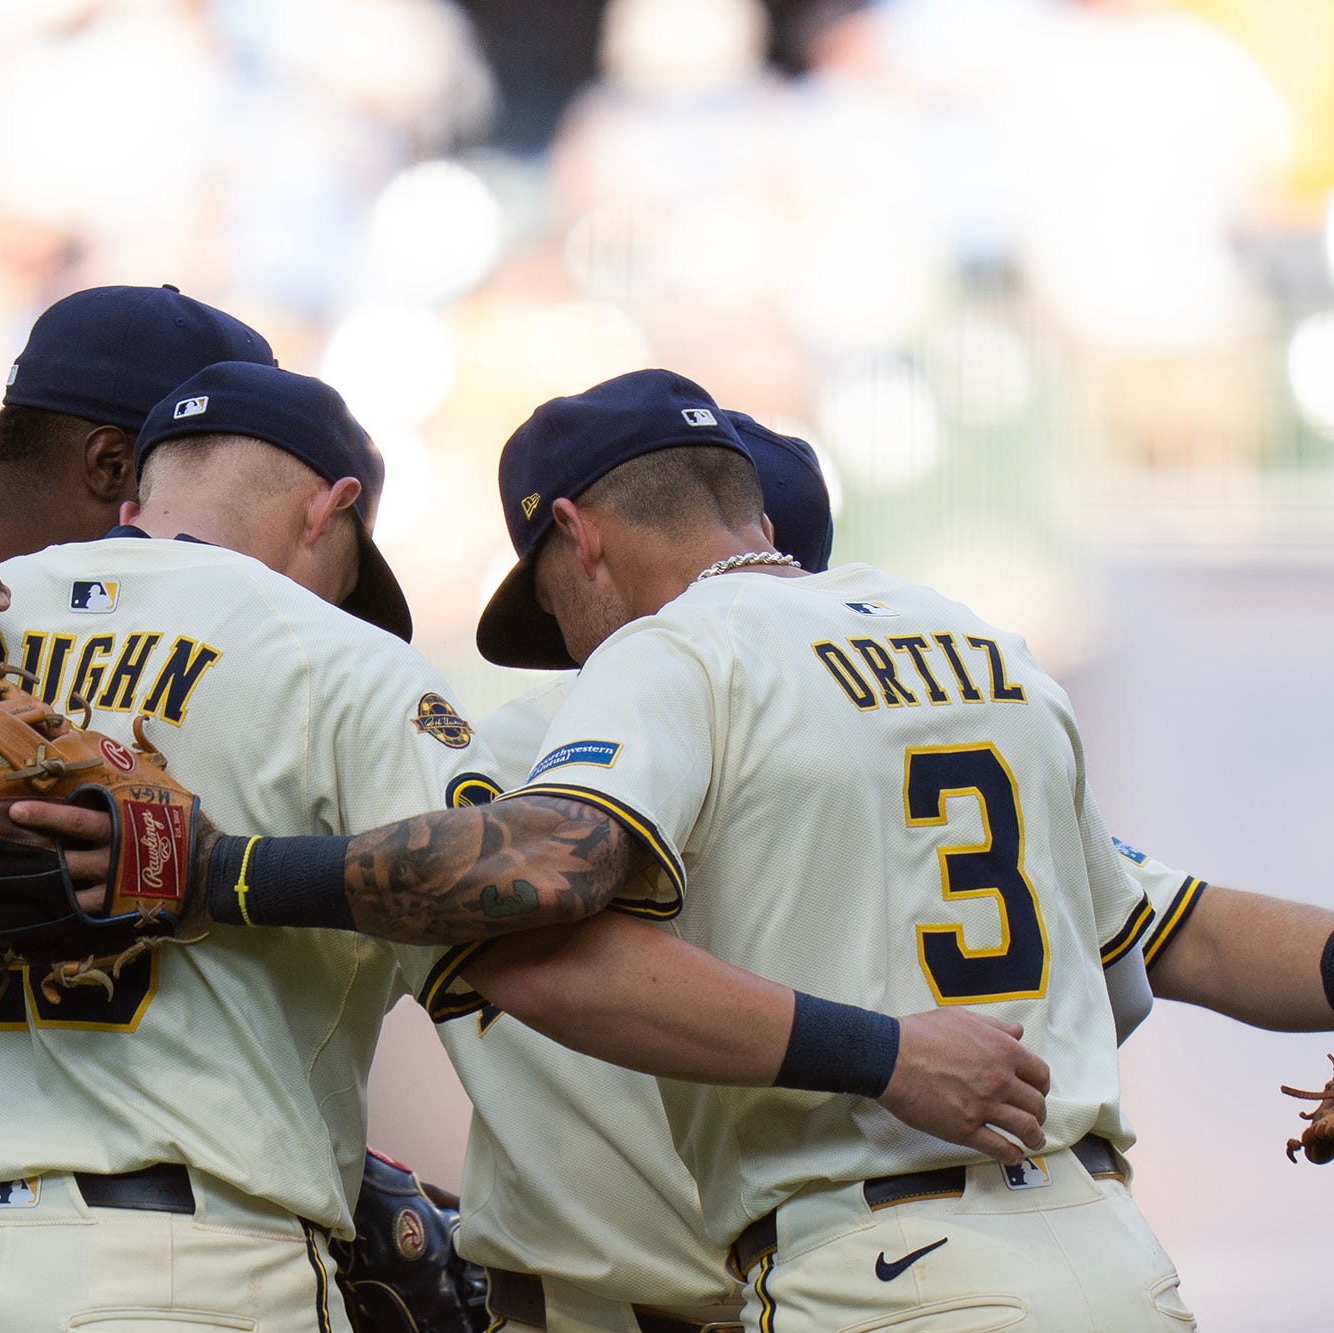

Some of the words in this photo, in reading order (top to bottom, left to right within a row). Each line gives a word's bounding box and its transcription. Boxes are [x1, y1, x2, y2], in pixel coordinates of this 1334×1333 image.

[811, 631, 1028, 712] ORTIZ
[141, 808, 168, 888] Rawlings
[902, 741, 1050, 1007] 3
